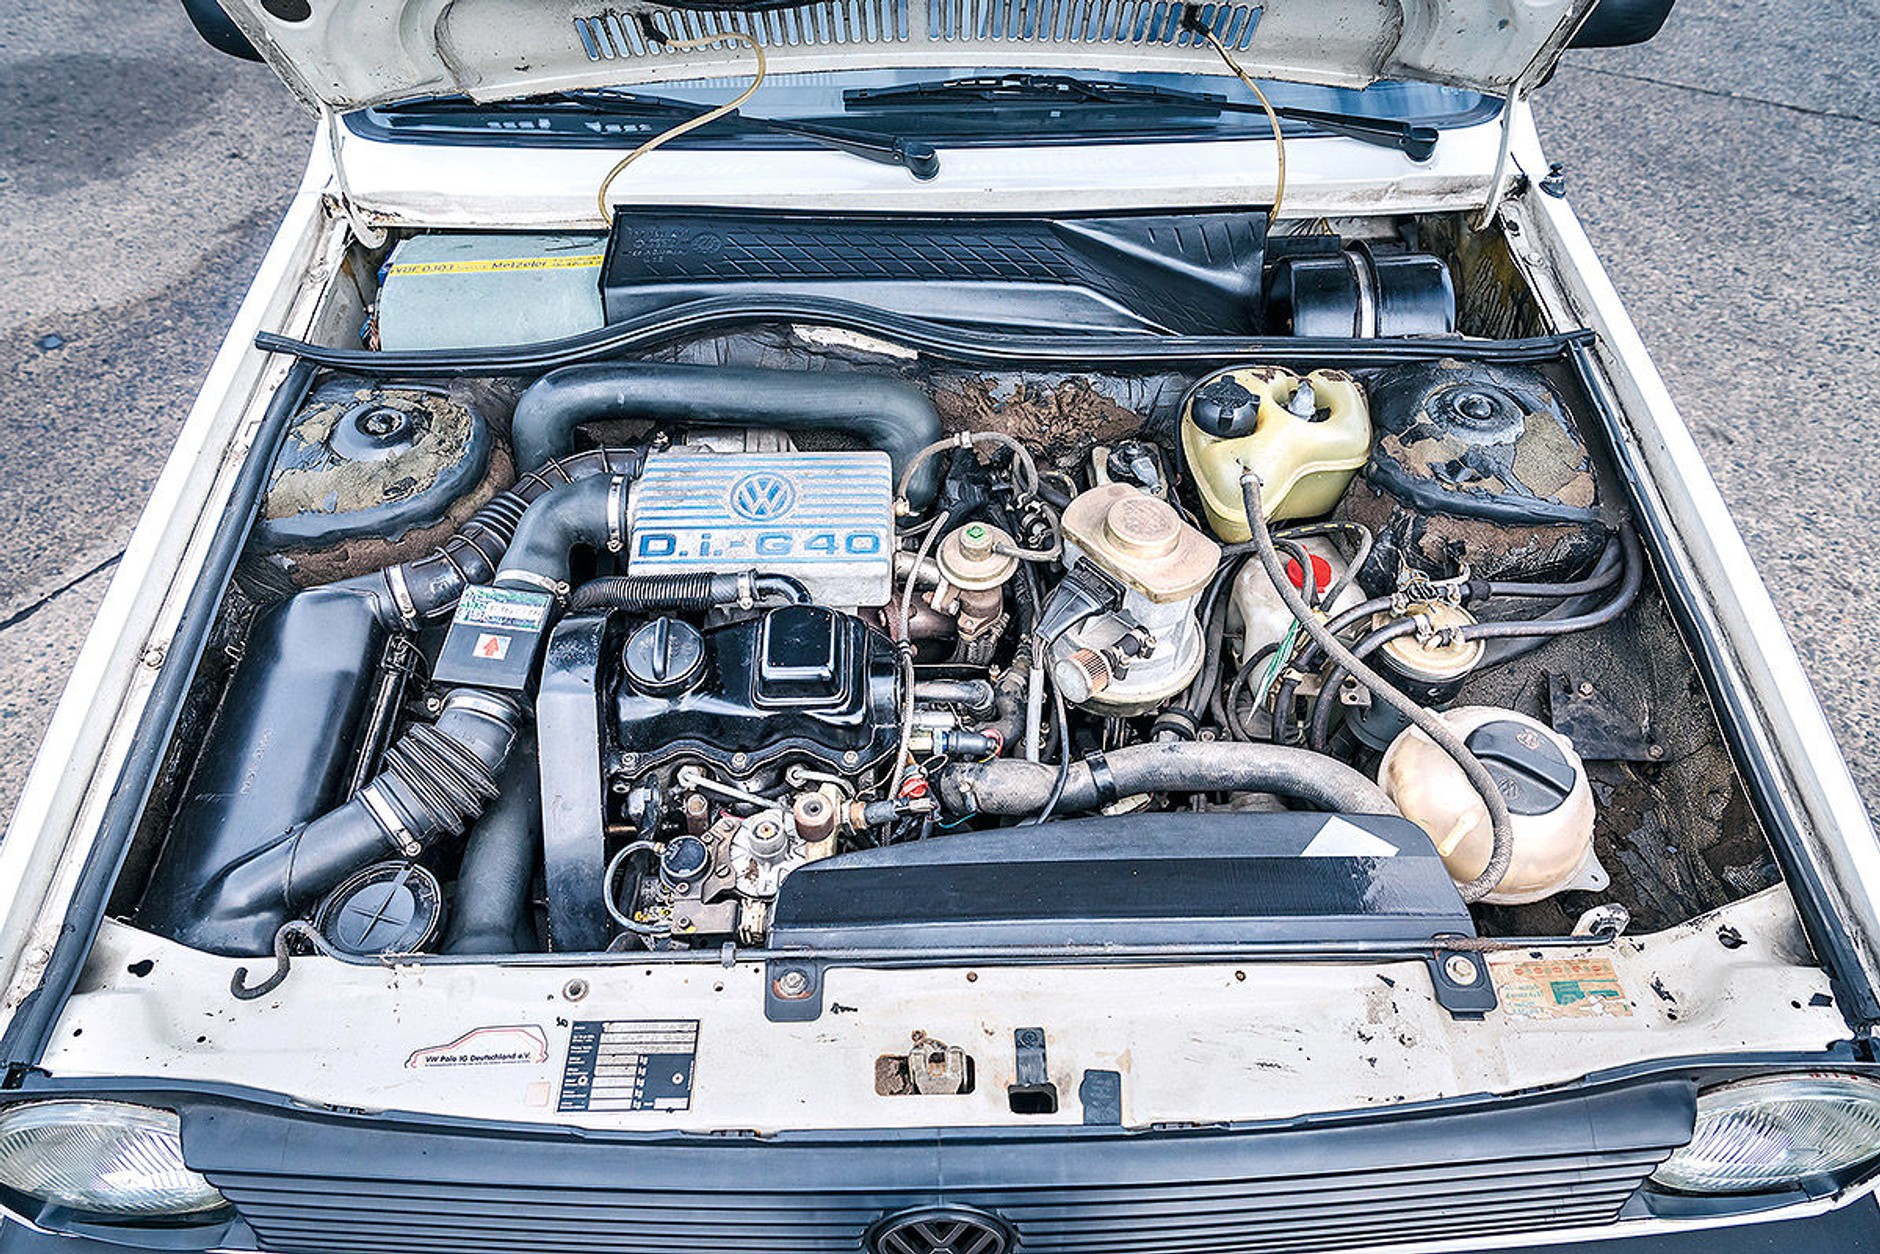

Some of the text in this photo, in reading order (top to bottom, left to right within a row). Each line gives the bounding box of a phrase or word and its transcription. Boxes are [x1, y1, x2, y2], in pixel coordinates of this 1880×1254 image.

[491, 260, 547, 269] Metzeler
[736, 475, 790, 518] VW
[425, 1055, 440, 1063] VW
[440, 1054, 457, 1063] Polo
[470, 1051, 516, 1062] Deutschland
